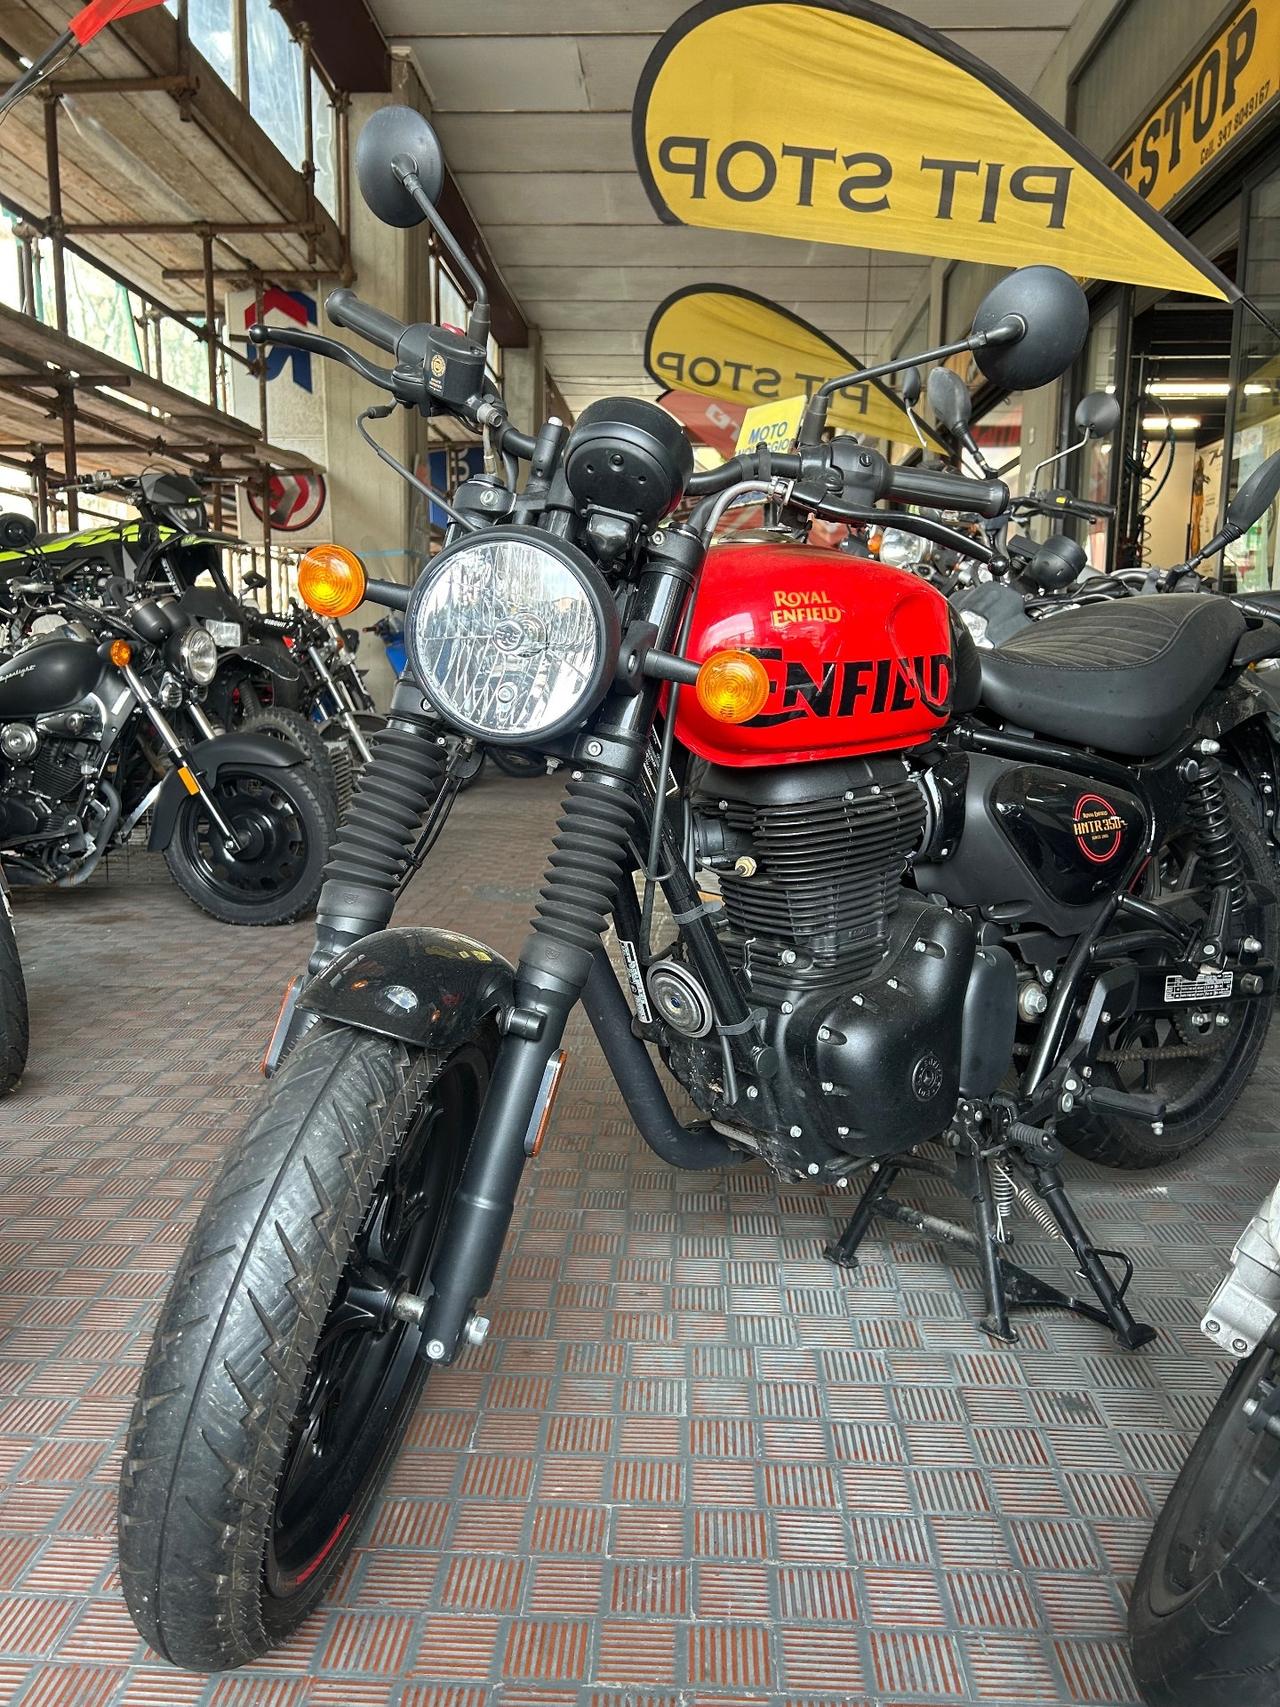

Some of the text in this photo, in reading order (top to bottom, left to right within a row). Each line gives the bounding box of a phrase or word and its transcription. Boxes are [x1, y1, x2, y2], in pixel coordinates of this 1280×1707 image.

[1217, 120, 1232, 147] 347
[1233, 80, 1271, 130] 8049167
[749, 421, 788, 444] MOTO
[773, 590, 832, 608] ROYAL
[772, 606, 842, 627] ENFIELD
[1073, 817, 1122, 835] HNTR 350
